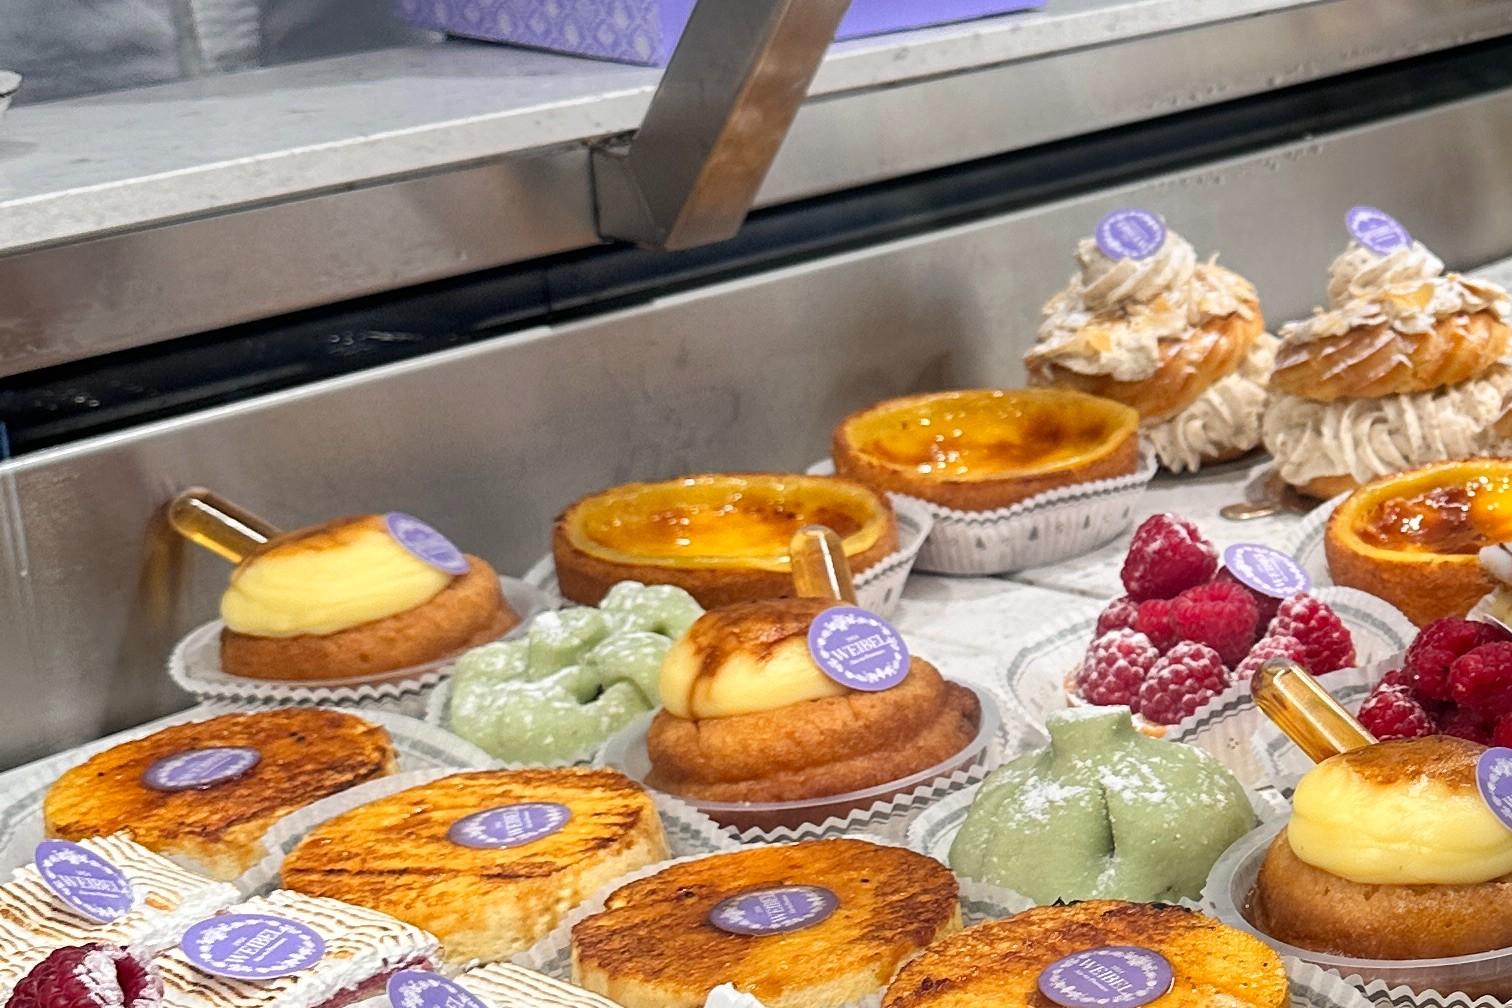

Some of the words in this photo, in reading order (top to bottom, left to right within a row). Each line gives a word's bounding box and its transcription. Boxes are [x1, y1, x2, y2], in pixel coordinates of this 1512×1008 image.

[831, 634, 889, 661] WEIBEL
[227, 927, 287, 965] WEIBEL
[1080, 957, 1132, 996] WEIBEL
